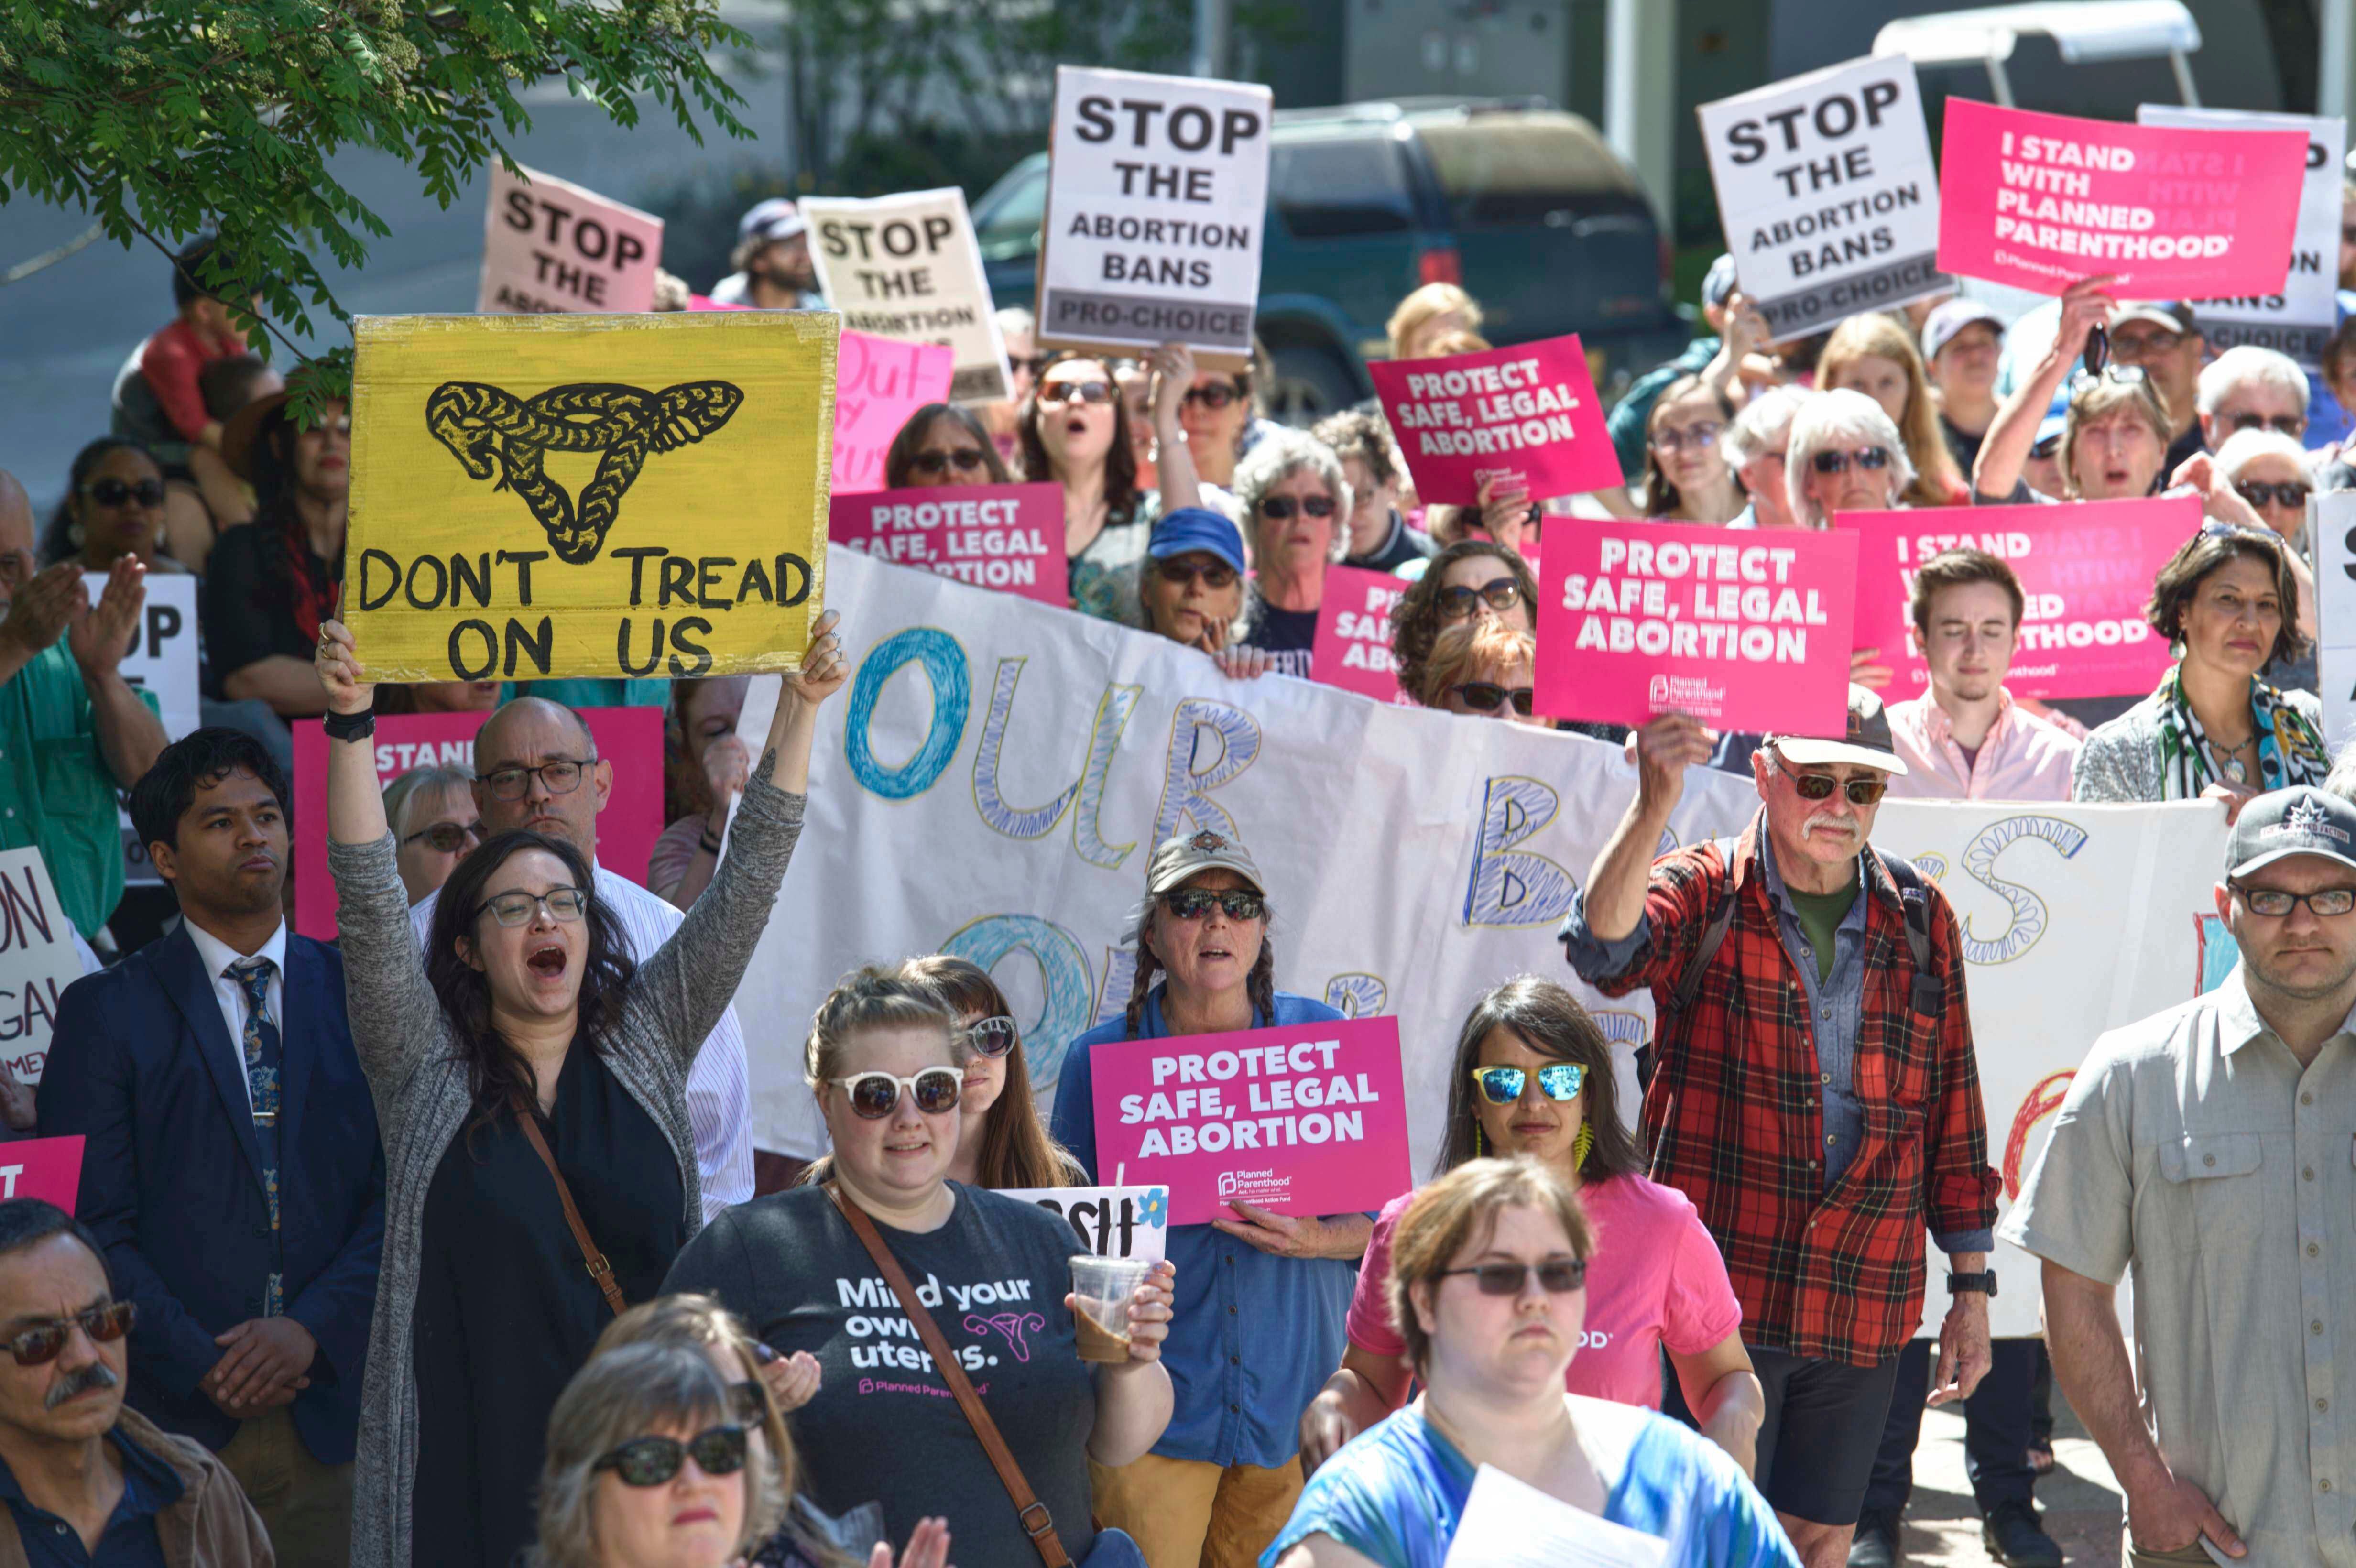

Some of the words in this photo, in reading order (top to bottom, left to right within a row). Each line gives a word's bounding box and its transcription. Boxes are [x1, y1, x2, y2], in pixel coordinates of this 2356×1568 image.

[1075, 96, 1260, 154] STOP
[1726, 79, 1900, 166] STOP
[1774, 144, 1874, 198] THE
[2001, 132, 2013, 155] I
[2022, 137, 2135, 171] STAND
[1113, 161, 1213, 203] THE
[2000, 161, 2091, 197] WITH
[503, 190, 644, 271] STOP
[1069, 213, 1250, 250] ABORTION
[1750, 182, 1920, 253] ABORTION
[1997, 189, 2154, 231] PLANNED
[821, 216, 952, 259] STOP
[1789, 226, 1895, 278] BANS
[1995, 216, 2230, 260] PARENTHOOD
[533, 249, 608, 307] THE
[855, 267, 935, 298] THE
[1102, 253, 1211, 287] BANS
[1763, 262, 1940, 325] PRO-CHOICE
[846, 307, 974, 332] ABORTION
[1058, 300, 1248, 334] PRO-CHOICE
[1407, 359, 1539, 398] PROTECT
[1398, 401, 1473, 429] SAFE,
[1478, 384, 1579, 423] LEGAL
[1420, 414, 1574, 456] ABORTION
[872, 500, 1019, 531] PROTECT
[849, 532, 939, 562] SAFE,
[947, 529, 1048, 557] LEGAL
[1601, 537, 1796, 584] PROTECT
[1897, 536, 1909, 563] I
[359, 548, 548, 611] DON'T
[611, 547, 815, 611] TREAD
[1562, 574, 1680, 621] SAFE,
[1695, 583, 1827, 625] LEGAL
[448, 616, 552, 681] ON
[618, 616, 713, 679] US
[1575, 614, 1806, 664] ABORTION
[1152, 1040, 1340, 1086] PROTECT
[1120, 1087, 1236, 1124] SAFE,
[1249, 1073, 1379, 1112] LEGAL
[1138, 1110, 1363, 1158] ABORTION
[1237, 1168, 1273, 1179] Planned
[1238, 1176, 1289, 1188] Parenthood
[1036, 1198, 1142, 1256] SH
[947, 1279, 1031, 1312] your
[851, 1340, 998, 1373] uters.
[876, 1381, 921, 1394] Planned
